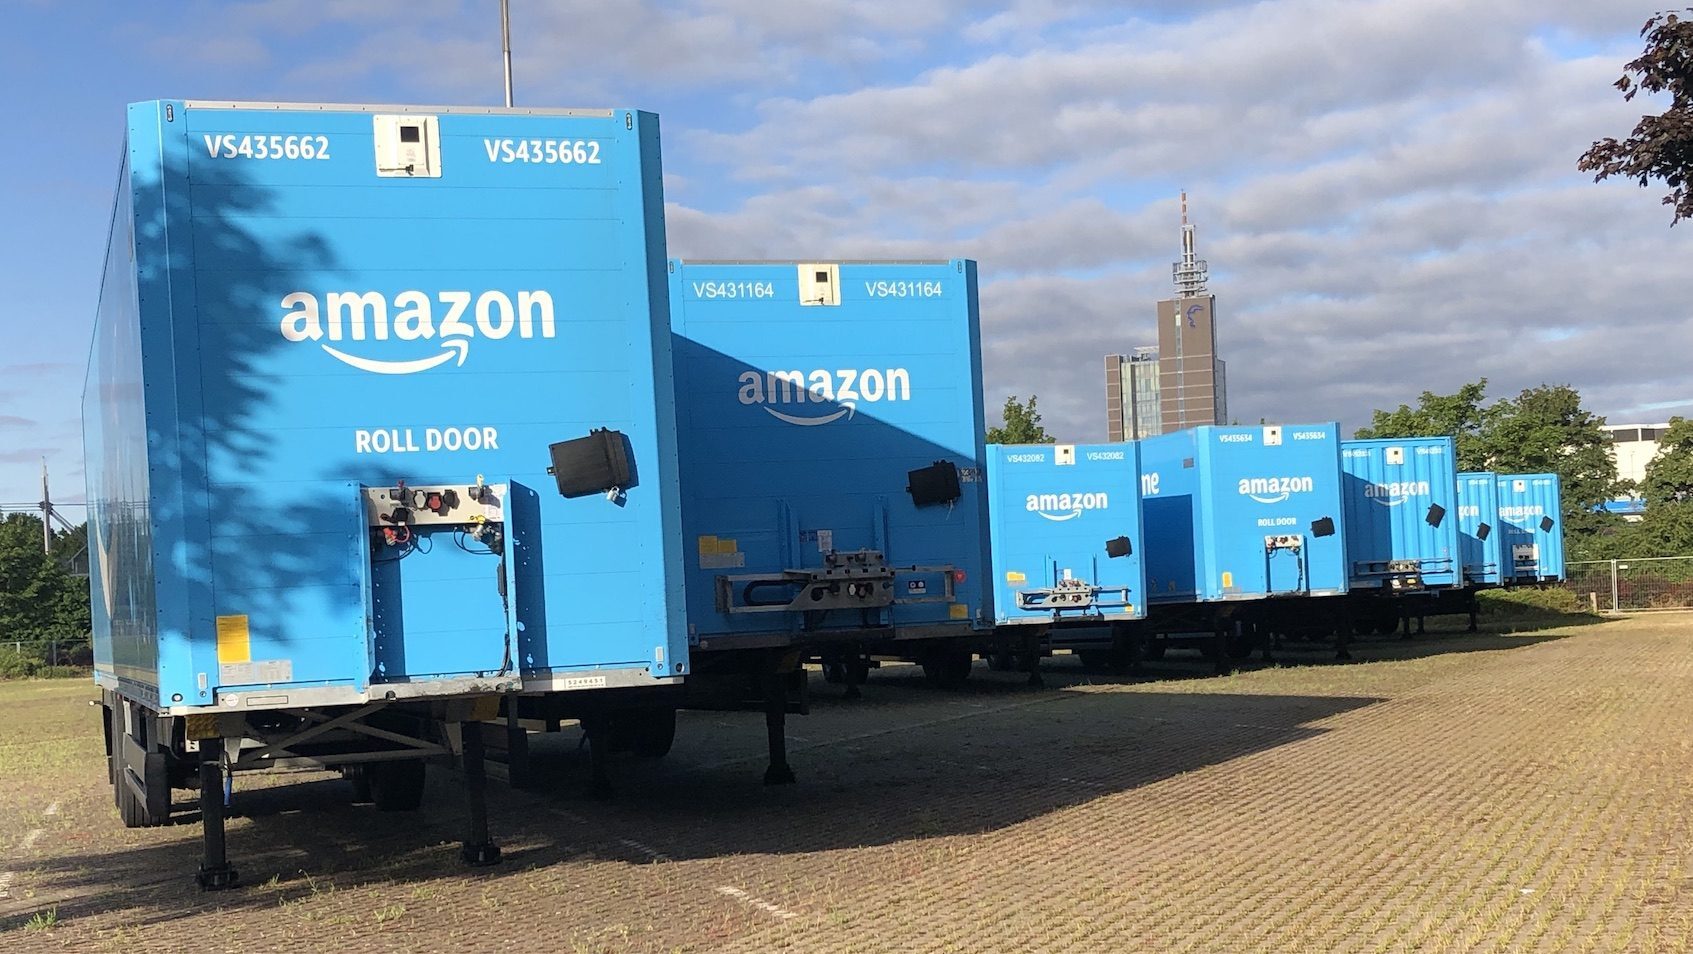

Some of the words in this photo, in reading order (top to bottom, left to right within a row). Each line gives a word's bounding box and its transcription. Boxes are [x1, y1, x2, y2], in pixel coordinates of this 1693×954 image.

[203, 134, 331, 160] VS435662
[483, 138, 602, 164] VS435662
[692, 281, 775, 299] VS431164
[864, 281, 943, 298] VS431164
[279, 289, 556, 343] amazon
[737, 367, 911, 405] amazon
[355, 428, 420, 454] ROLL
[425, 426, 499, 452] DOOR
[1238, 476, 1313, 495] amazon
[1364, 480, 1430, 498] amazon
[1025, 491, 1108, 512] amazon
[1498, 505, 1543, 517] amazon
[1257, 517, 1276, 527] ROLL
[1276, 516, 1297, 526] DOOR
